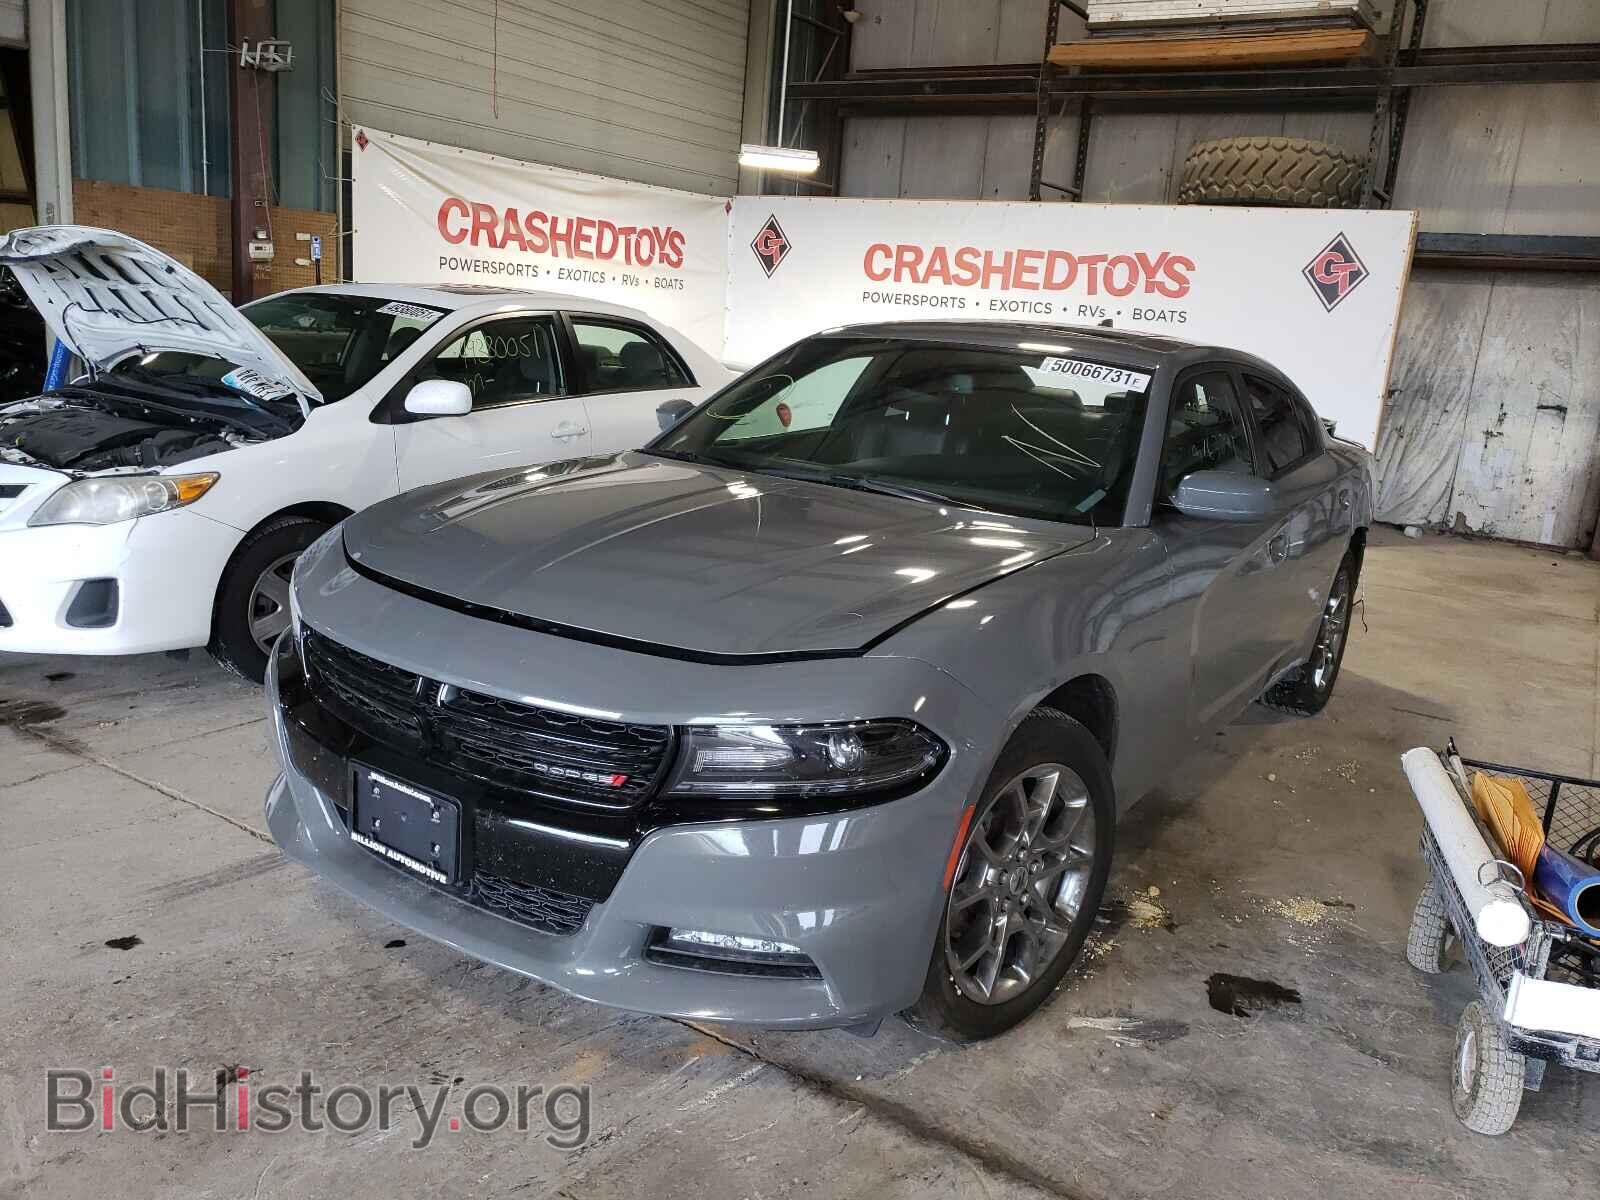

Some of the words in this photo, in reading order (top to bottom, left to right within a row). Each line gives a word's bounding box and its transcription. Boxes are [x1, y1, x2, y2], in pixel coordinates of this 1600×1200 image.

[438, 197, 686, 269] CRASHEDTOYS
[439, 256, 539, 278] POWERSPORTS
[558, 267, 606, 284] EXOTICS
[621, 274, 640, 287] RVs
[654, 277, 684, 291] BOATS
[863, 243, 1196, 299] CRASHEDTOYS
[862, 291, 966, 309] POWERSPORTS
[989, 299, 1053, 315] EXOTICS
[1077, 304, 1106, 319] RVs
[1132, 307, 1188, 324] BOATS
[533, 762, 613, 784] DODGE
[350, 831, 386, 856] BILLION
[386, 850, 447, 884] AUTOMOTIVE
